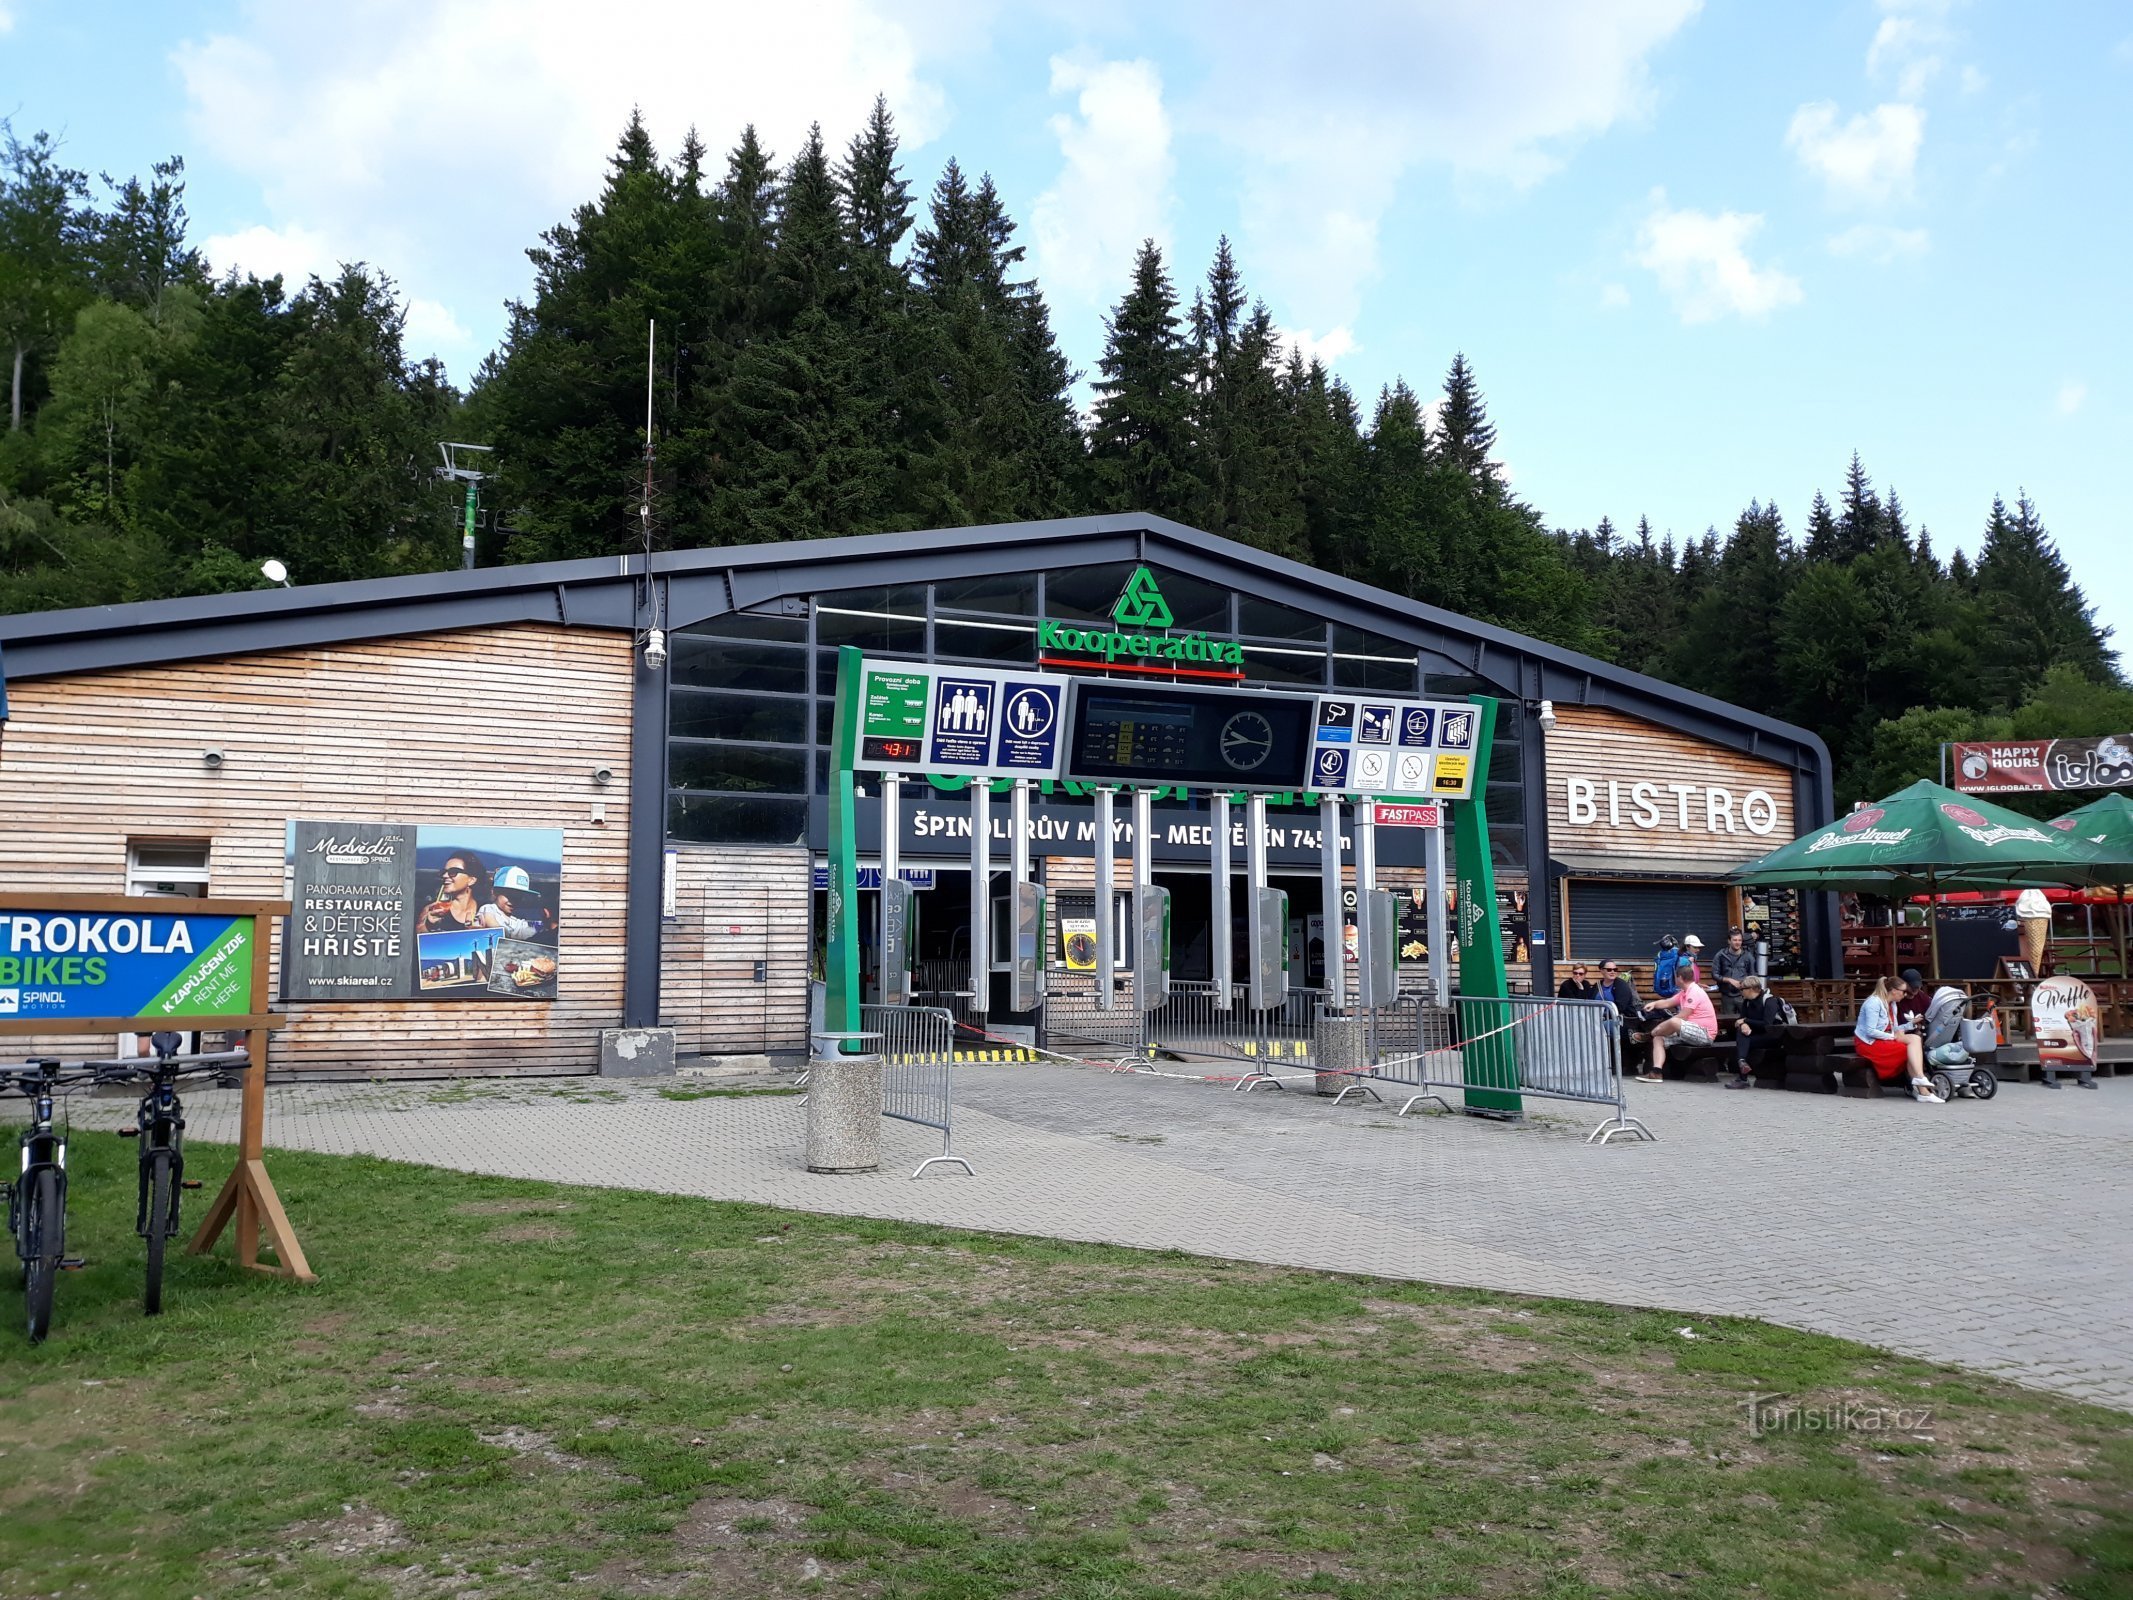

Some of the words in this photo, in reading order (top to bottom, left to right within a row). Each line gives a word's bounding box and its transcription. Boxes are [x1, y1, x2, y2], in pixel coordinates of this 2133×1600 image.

[1038, 620, 1245, 664] Kooperativa
[1991, 747, 2040, 758] HAPPY
[1992, 758, 2040, 768] HOURS
[2056, 750, 2133, 787] igloo
[1378, 809, 1437, 822] FASTPASS
[1567, 778, 1777, 835] BISTRO
[914, 811, 1069, 841] ŠPINLRŮV
[1077, 818, 1133, 842] MÝ
[307, 836, 396, 856] Medvědín
[306, 884, 403, 896] PANORAMATICKÁ
[305, 899, 403, 911] RESTAURACE
[1465, 880, 1473, 947] Kooperativa
[304, 915, 318, 932] &
[323, 912, 401, 933] DĚTSKÉ
[303, 933, 401, 956] HŘIŠTĚ
[0, 957, 106, 985] BIKES
[162, 1001, 175, 1013] K
[170, 949, 227, 1005] ZAPŮJČENÍ
[223, 932, 246, 955] ZDE
[308, 976, 393, 986] www.skiareal.cz
[193, 977, 221, 1005] RENT
[219, 962, 238, 980] ME
[212, 980, 240, 1009] HERE
[22, 991, 66, 1004] SPINDL
[2037, 984, 2090, 1010] Waffle
